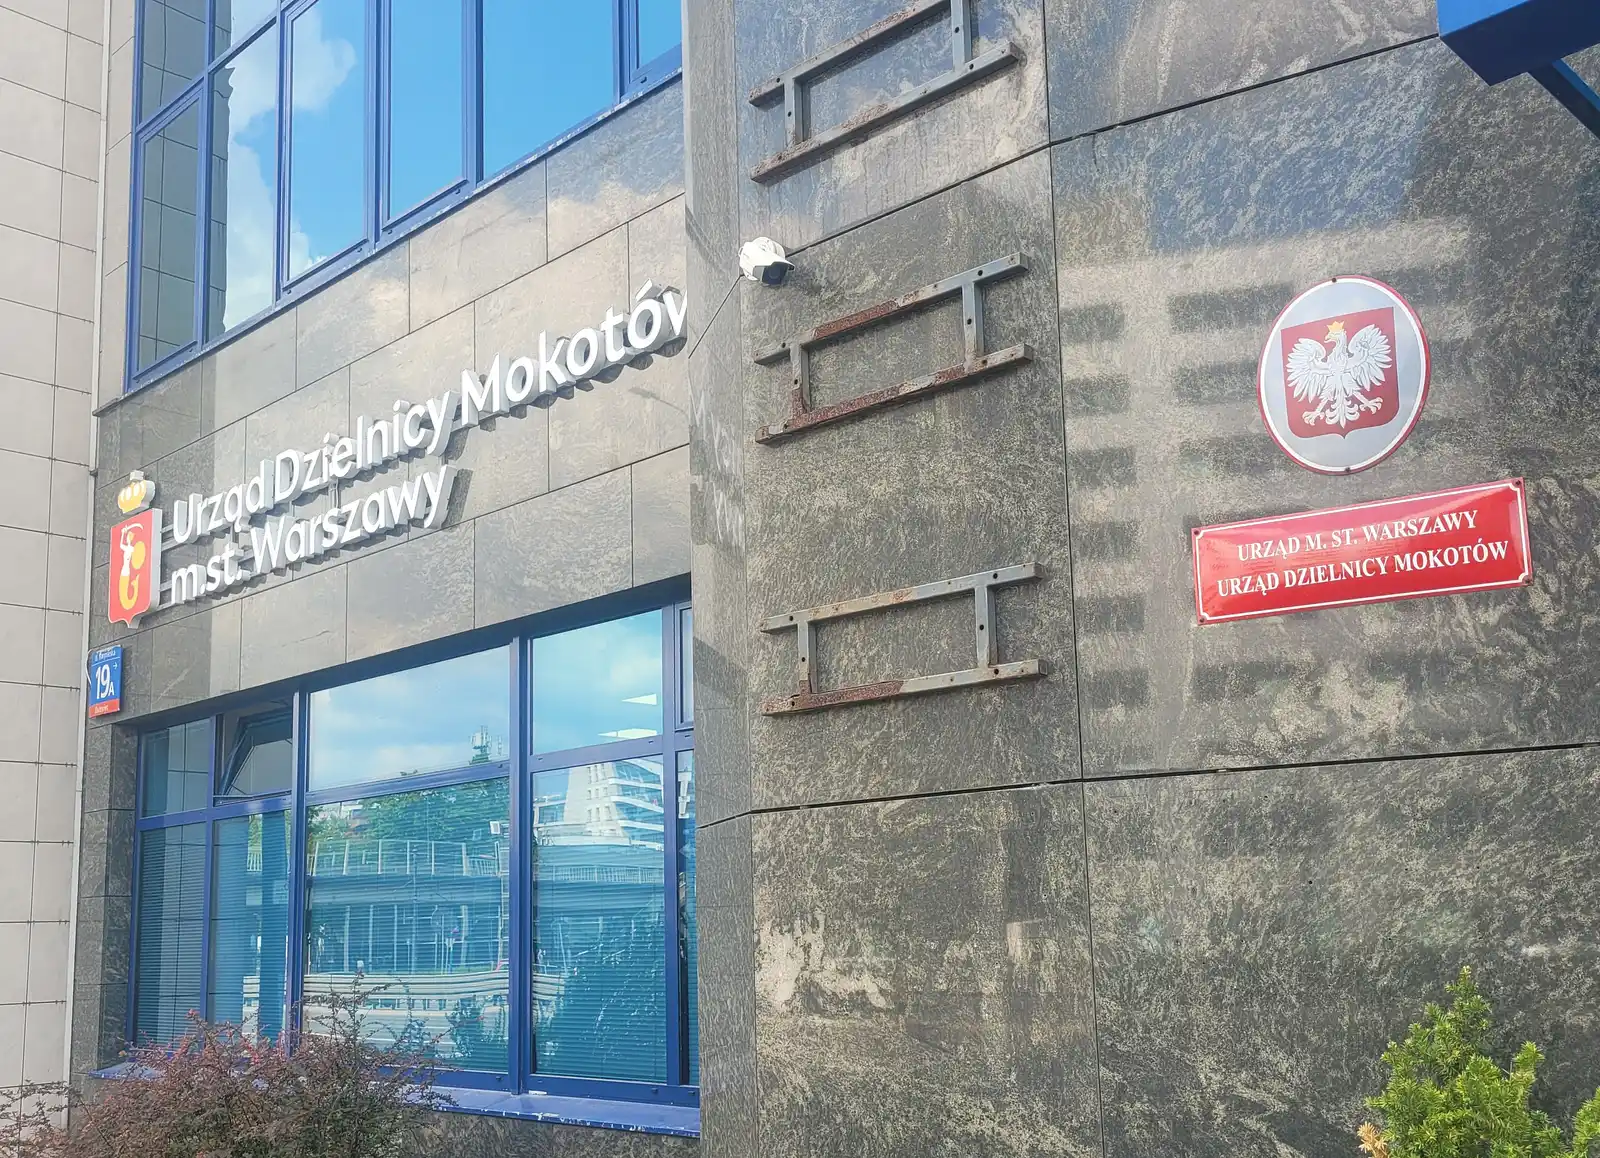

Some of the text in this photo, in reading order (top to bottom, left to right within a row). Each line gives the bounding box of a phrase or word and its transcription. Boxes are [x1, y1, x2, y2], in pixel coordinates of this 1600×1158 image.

[174, 459, 270, 544] Urząd
[275, 390, 454, 506] Dzielnicy
[250, 464, 455, 575] Warszawy
[1237, 509, 1479, 562] URZĄD M. ST. WARSZAWY
[1217, 537, 1510, 598] URZĄD DZIELNICY MOKOTÓW
[95, 663, 115, 700] 19A
